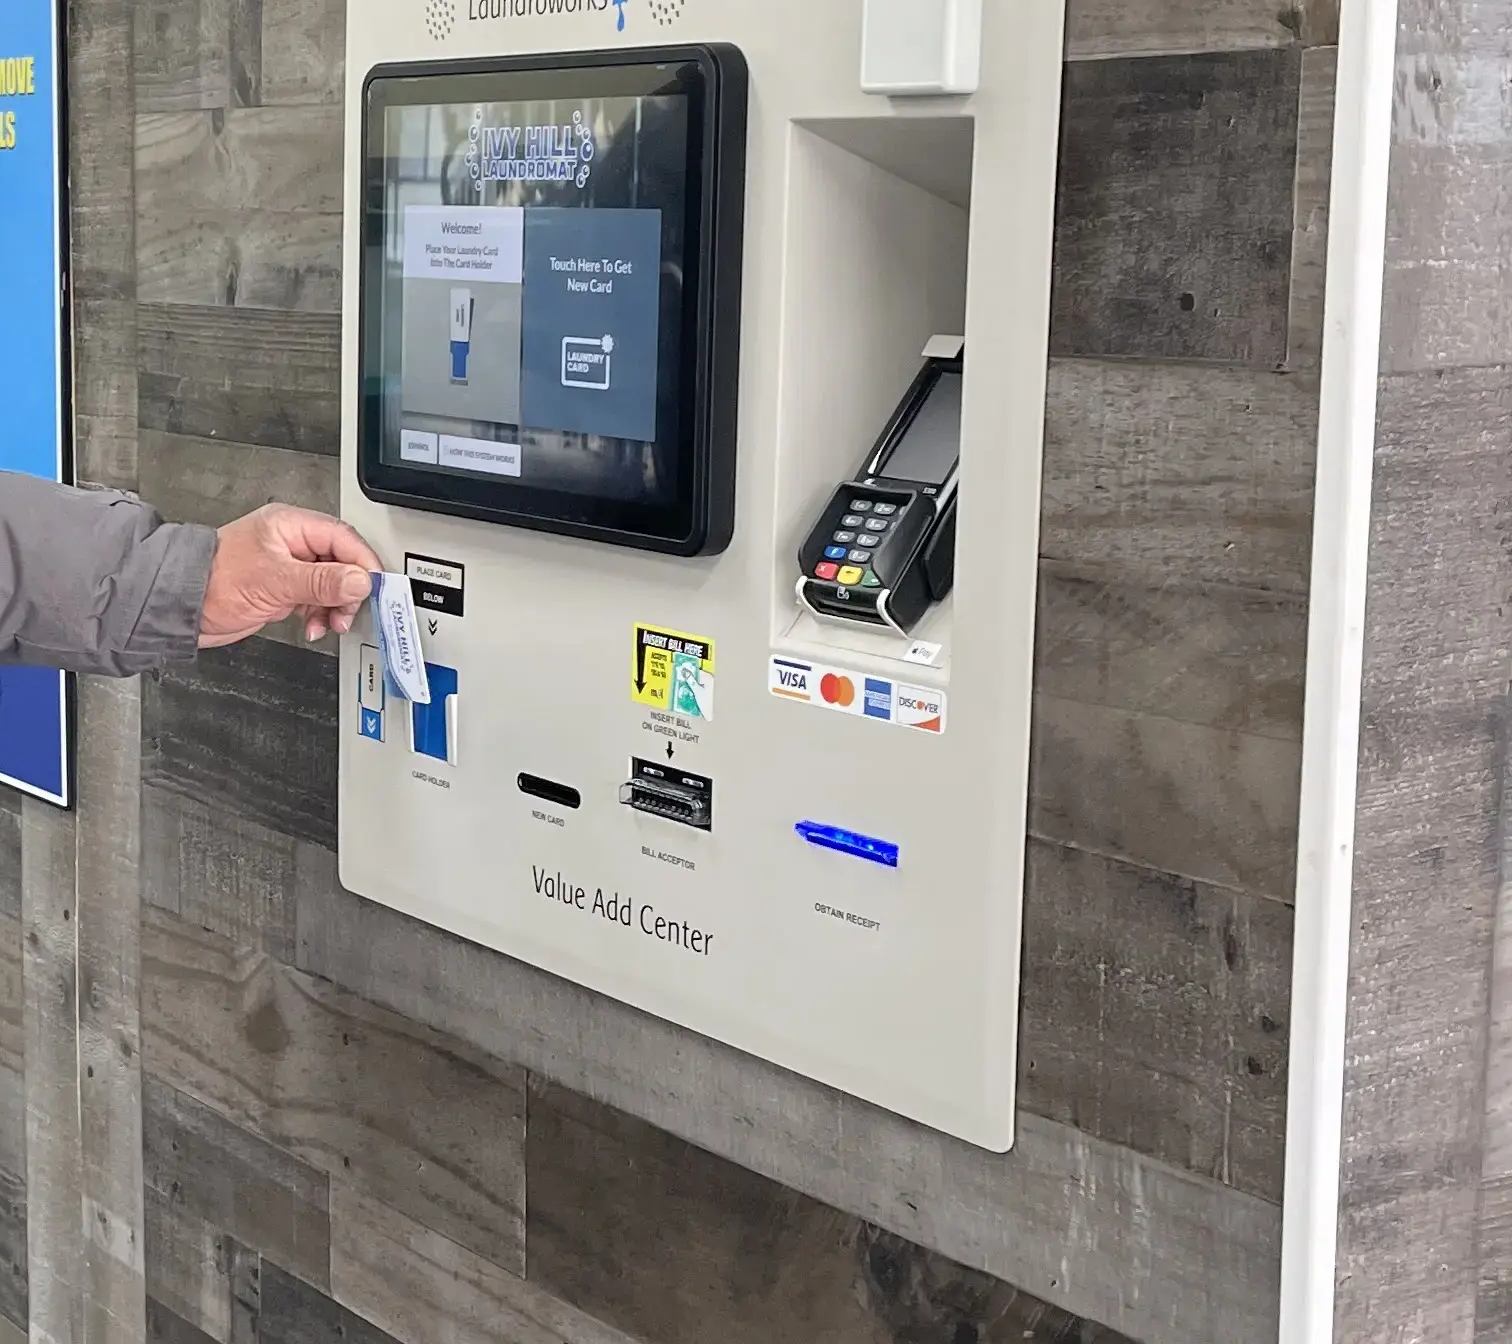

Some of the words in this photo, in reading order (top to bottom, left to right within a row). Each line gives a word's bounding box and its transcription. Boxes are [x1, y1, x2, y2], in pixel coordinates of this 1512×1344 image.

[482, 126, 521, 159] IVY
[524, 125, 577, 159] HILL
[482, 159, 577, 181] LAUNDROMAT
[441, 222, 482, 234] Welcome!
[483, 245, 498, 256] Card
[444, 258, 455, 268] The
[455, 258, 470, 269] Card
[549, 257, 576, 272] Touch
[577, 258, 601, 273] Here
[601, 259, 613, 273] To
[614, 260, 632, 275] Get
[567, 277, 589, 292] New
[589, 278, 613, 293] Card
[567, 351, 605, 364] LAUNDRY
[567, 362, 589, 373] CARD
[416, 567, 435, 577] PLACE
[436, 570, 452, 581] CARD
[422, 591, 445, 604] BELOW
[643, 630, 668, 648] INSERT
[668, 638, 683, 652] BILL
[777, 669, 807, 690] VISA
[898, 696, 939, 714] DISCOVER
[650, 711, 675, 724] INSERT
[676, 717, 691, 730] BILL
[642, 721, 652, 731] ON
[654, 723, 677, 738] GREEN
[679, 732, 700, 744] LIGHT
[411, 770, 428, 782] CARD
[428, 777, 451, 789] HOLDER
[532, 810, 546, 821] NEW
[547, 815, 565, 827] CARD
[641, 845, 657, 858] BILL
[657, 851, 696, 871] ACCEPTOR
[532, 865, 585, 910] Value
[591, 888, 632, 926] Add
[639, 904, 714, 956] Center
[814, 902, 844, 920] OBTAIN
[846, 912, 881, 931] RECEIPT
